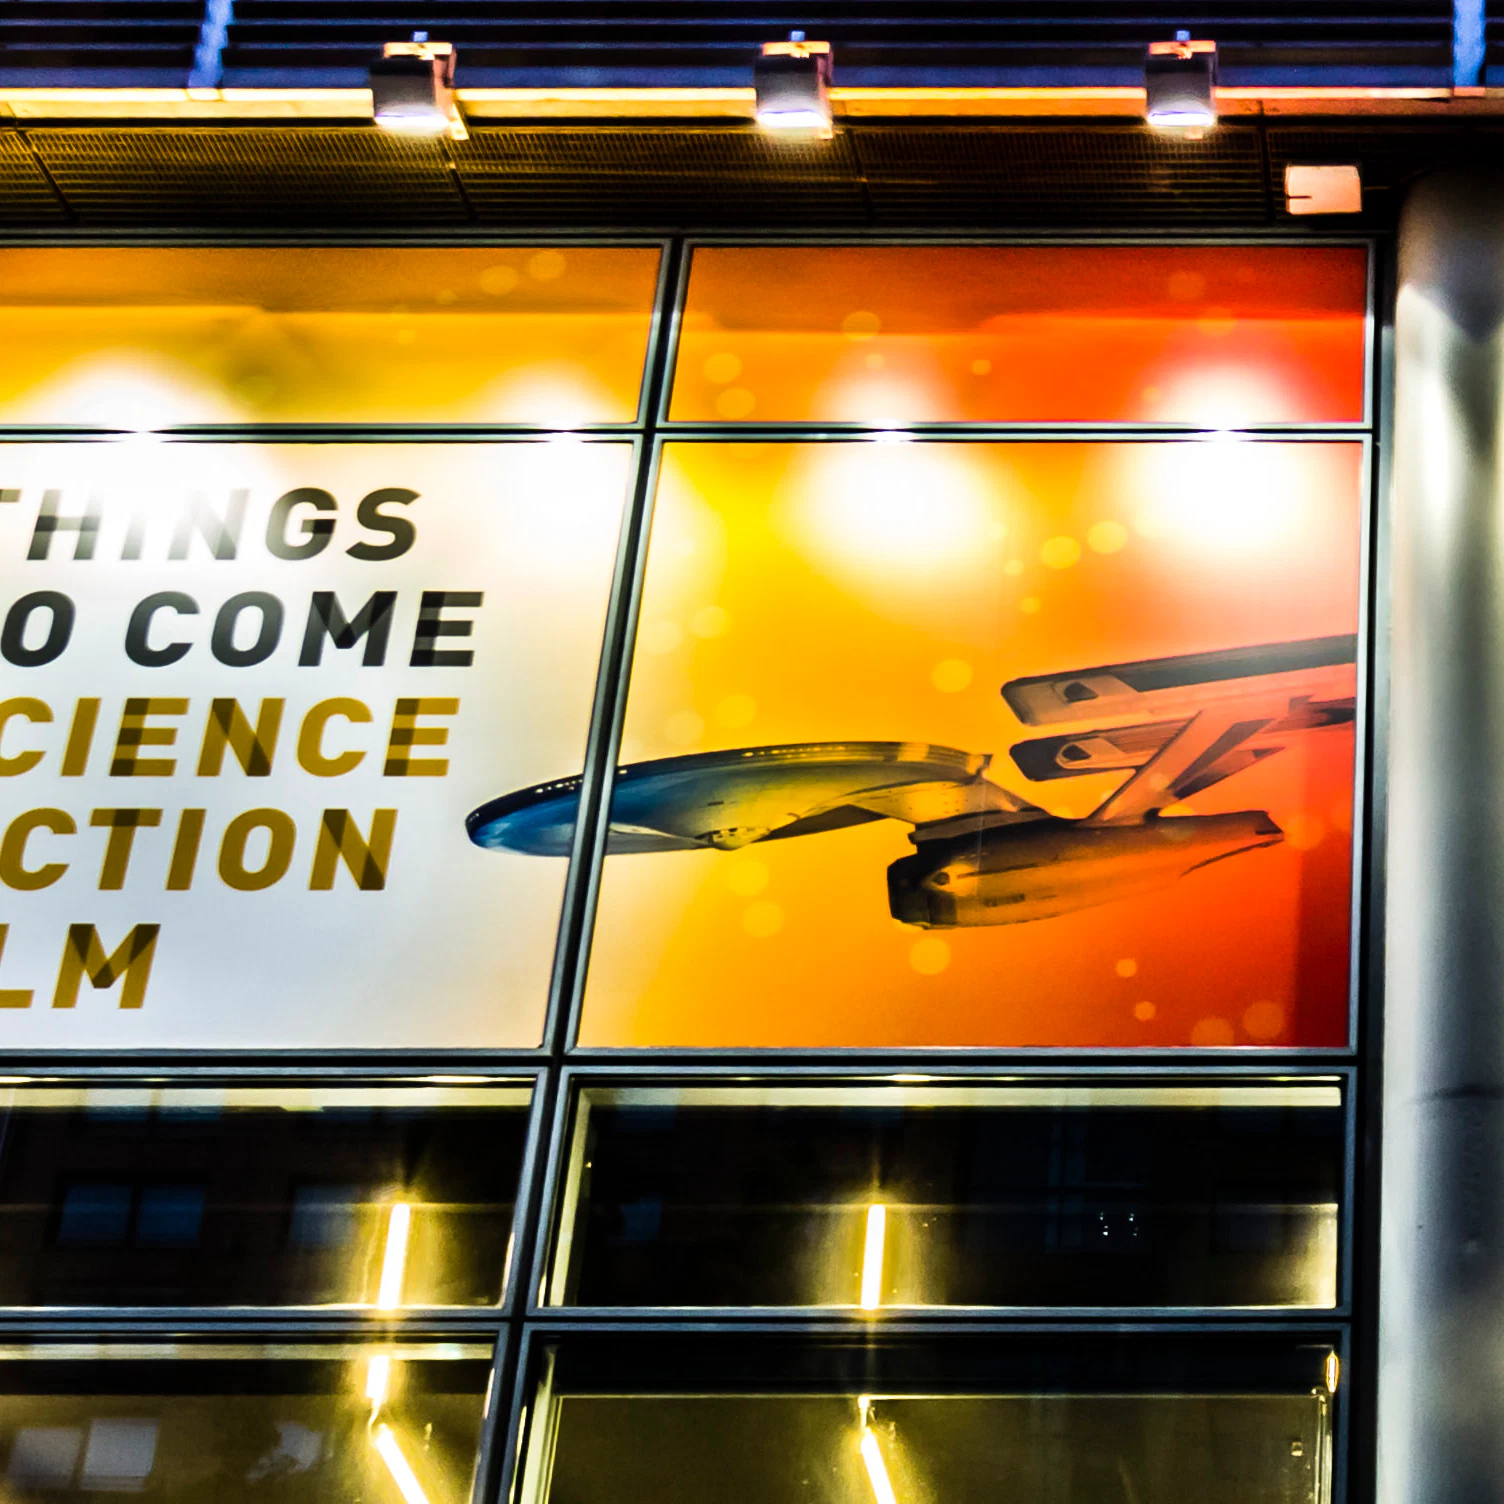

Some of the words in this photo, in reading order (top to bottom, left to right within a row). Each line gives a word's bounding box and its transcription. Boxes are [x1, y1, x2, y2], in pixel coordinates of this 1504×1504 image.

[124, 590, 485, 668] COME
[0, 697, 460, 778] CIENCE
[0, 807, 398, 892] CTION
